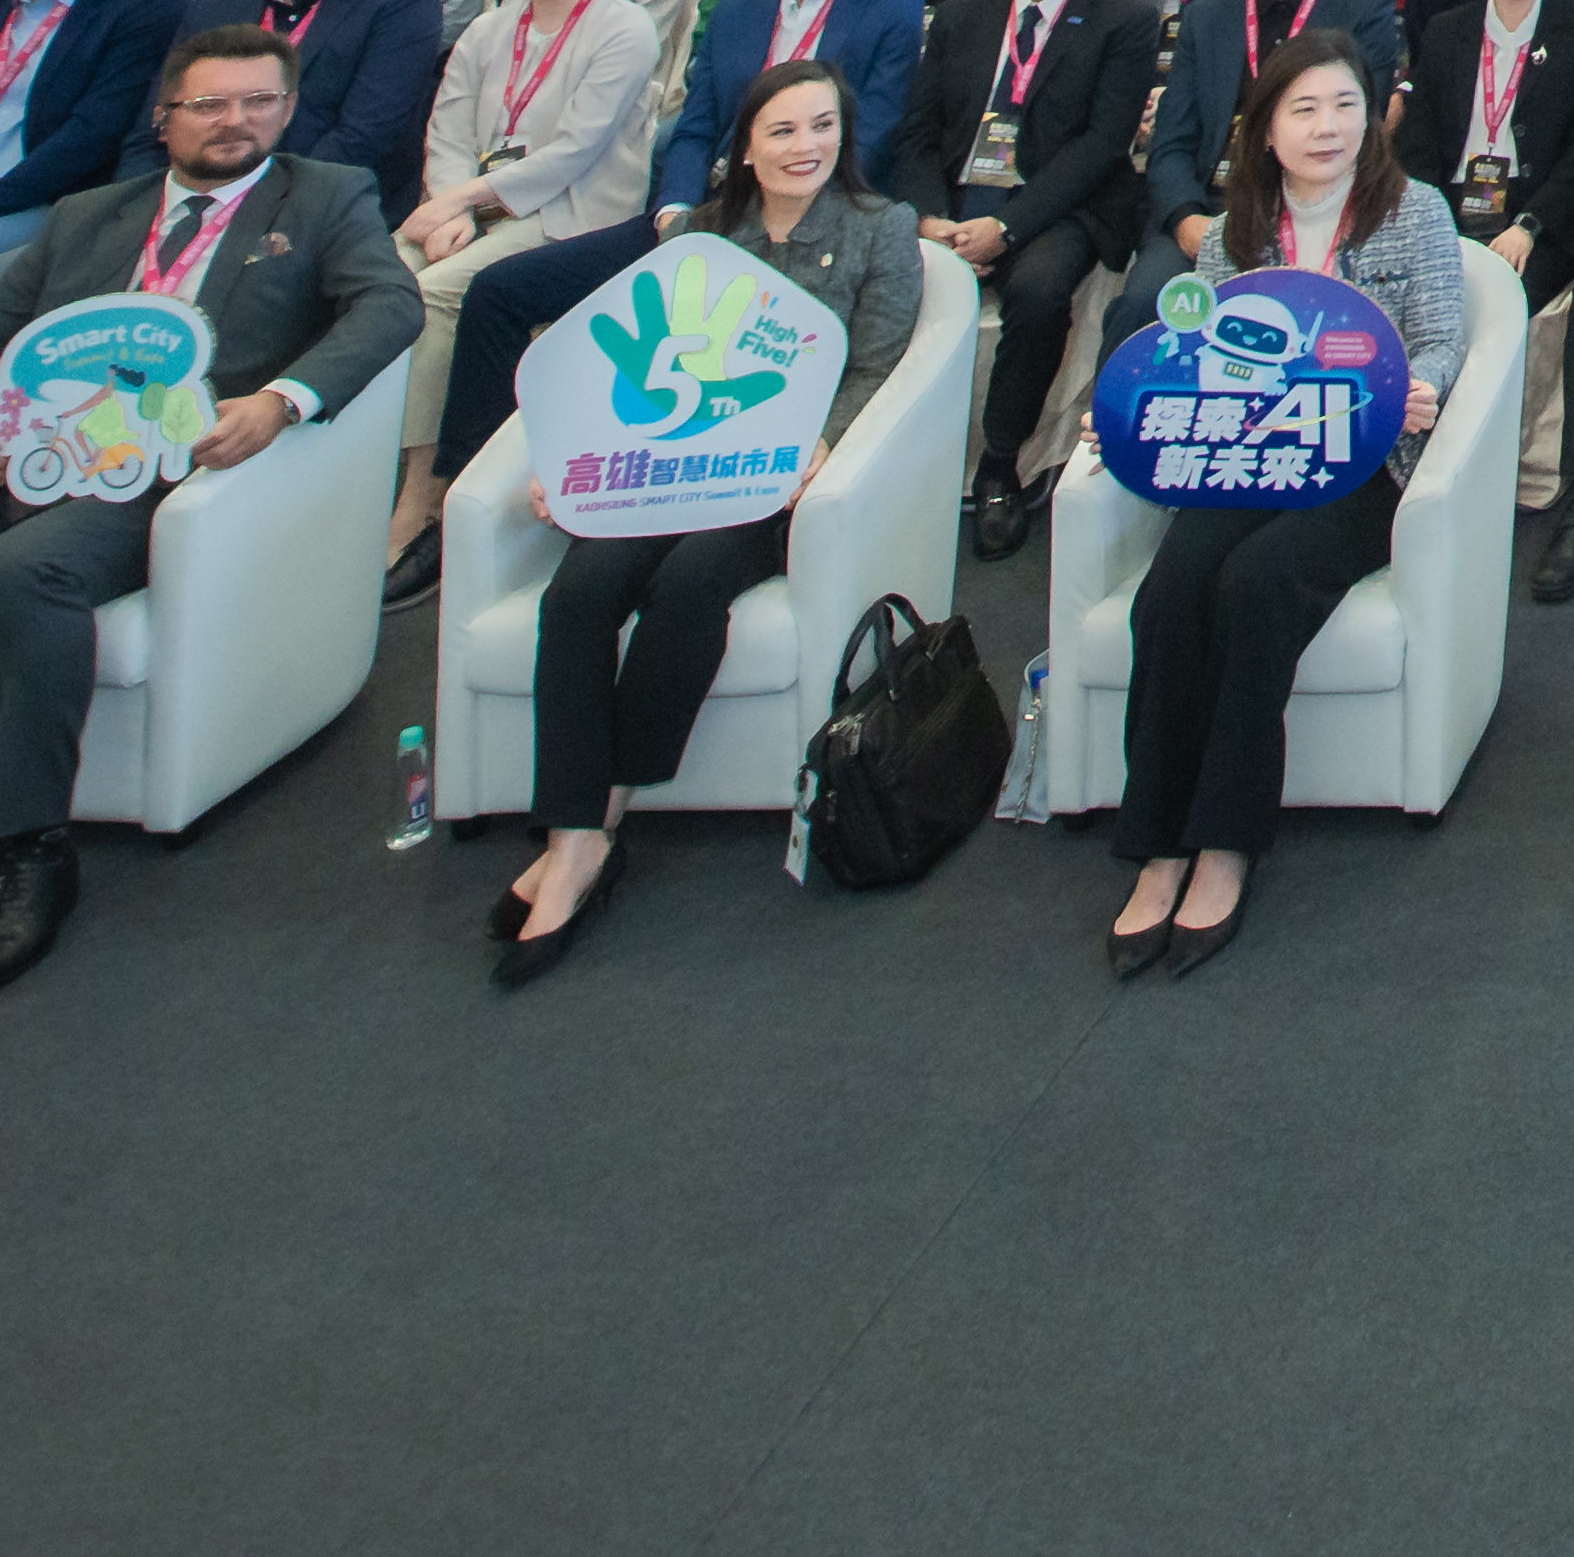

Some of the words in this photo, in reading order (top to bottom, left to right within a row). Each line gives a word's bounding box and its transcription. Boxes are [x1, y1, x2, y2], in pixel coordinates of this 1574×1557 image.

[1170, 292, 1202, 315] AI
[35, 324, 127, 366] Smart
[131, 322, 183, 354] City
[753, 314, 799, 344] High
[736, 330, 800, 369] Five!
[708, 396, 742, 417] Th
[560, 445, 801, 496] 高雄智慧城市展
[1151, 444, 1314, 491] 新未來
[639, 493, 677, 508] SMART
[679, 491, 702, 504] CITY
